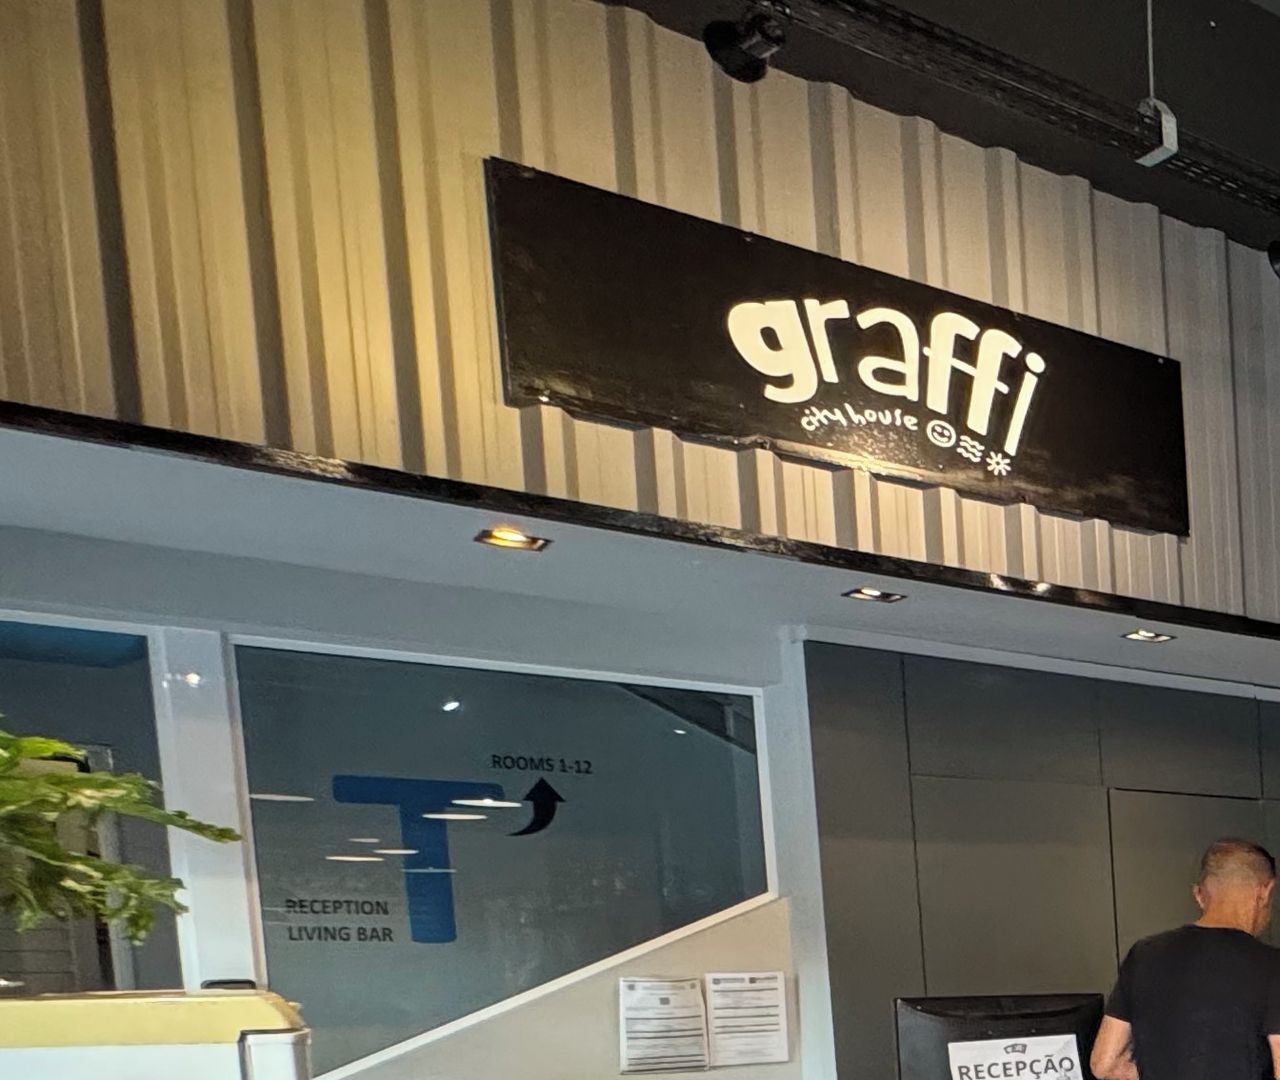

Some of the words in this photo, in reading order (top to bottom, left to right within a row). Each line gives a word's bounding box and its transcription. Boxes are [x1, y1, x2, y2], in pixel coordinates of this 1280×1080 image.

[728, 299, 1046, 456] graffi
[801, 406, 847, 431] city
[845, 403, 918, 430] house
[491, 754, 554, 771] ROOMS
[559, 758, 593, 774] 1-12
[285, 898, 389, 916] RECEPTION
[287, 925, 350, 942] LIVING
[357, 926, 394, 943] BAR
[957, 1054, 1075, 1080] RECEPÇÃO
